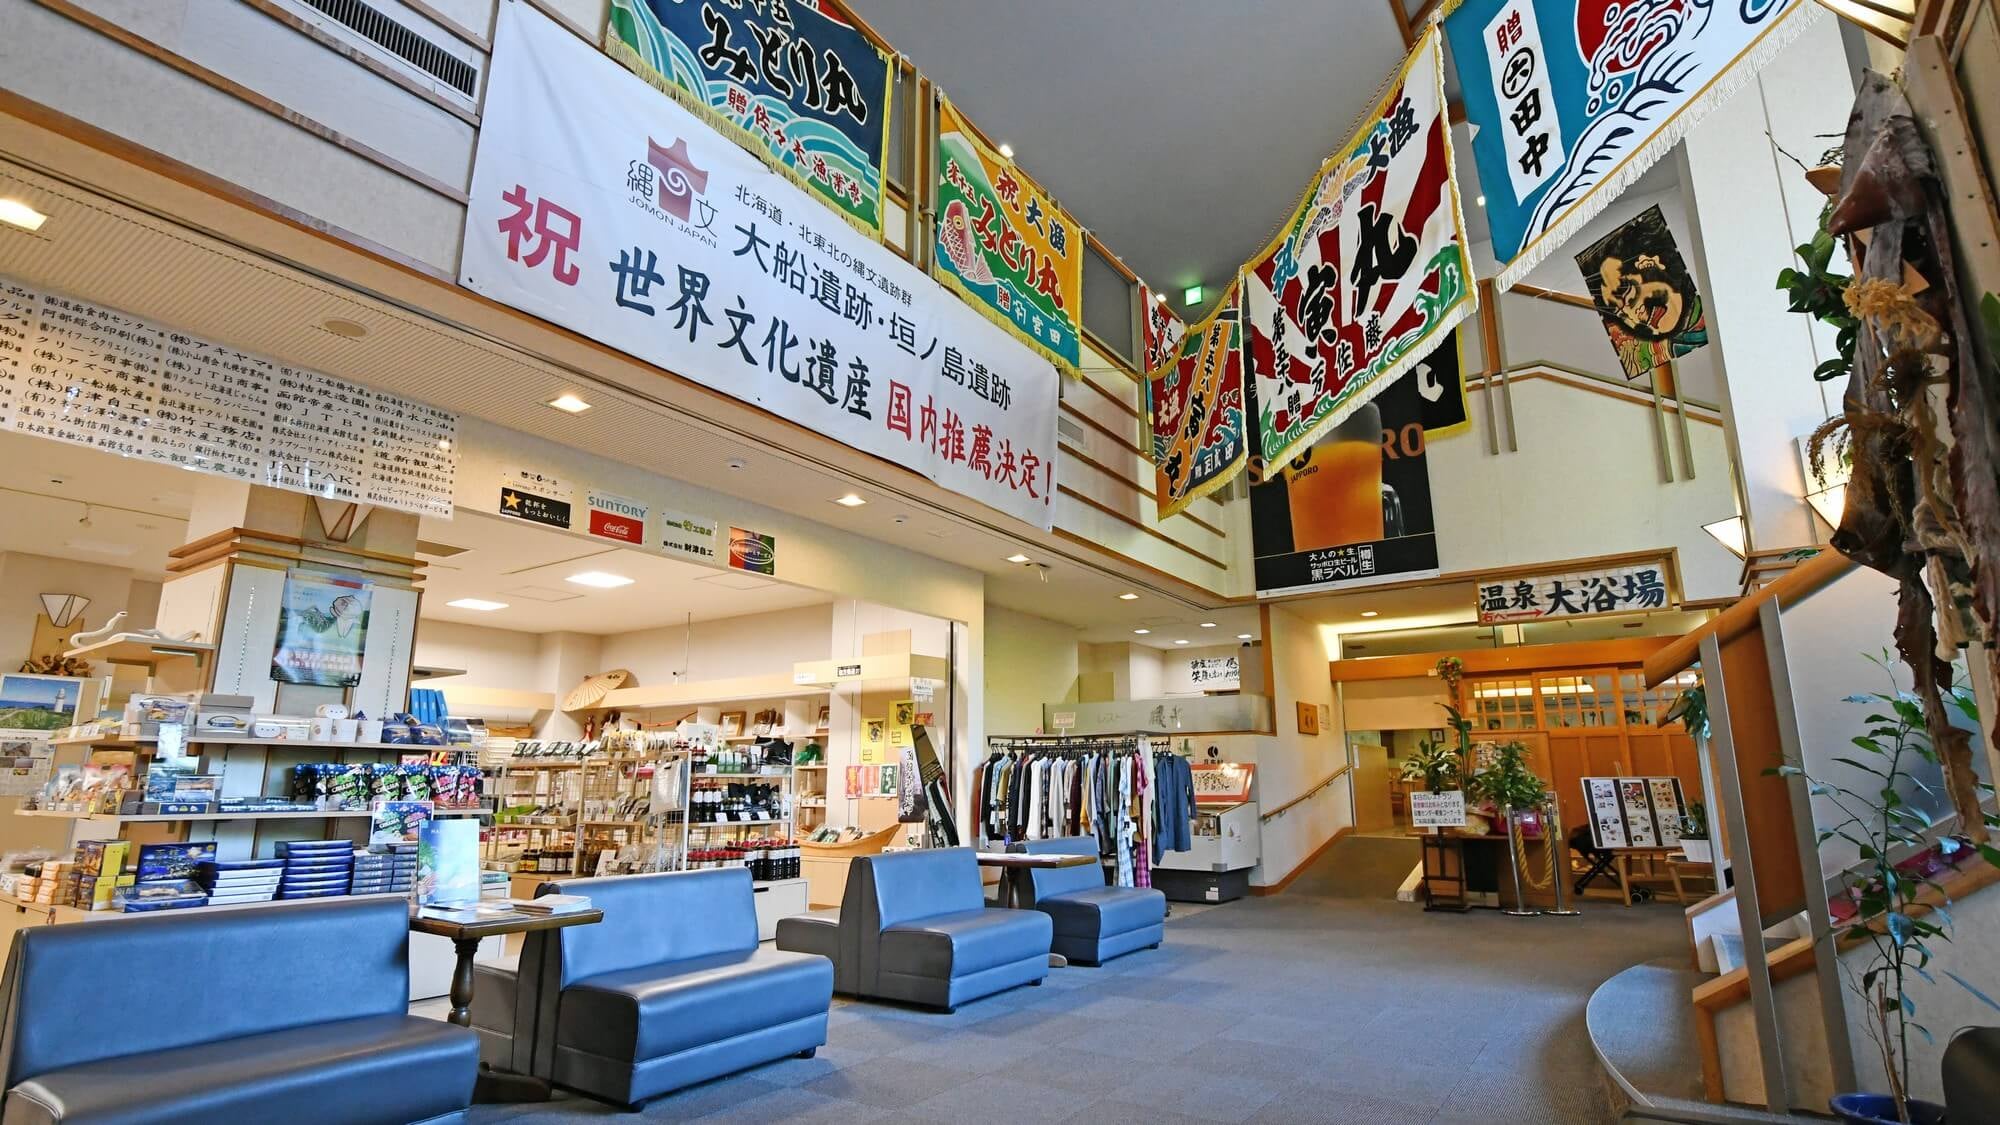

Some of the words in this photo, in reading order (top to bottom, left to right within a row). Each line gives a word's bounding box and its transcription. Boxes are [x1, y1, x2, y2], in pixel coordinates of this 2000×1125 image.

[700, 4, 868, 126] みどり丸
[1496, 9, 1523, 58] 贈
[728, 88, 748, 116] 贈
[1509, 88, 1549, 178] 田中
[498, 184, 582, 287] 祝
[628, 195, 676, 232] JOMON
[677, 223, 718, 249] JAPAN
[735, 184, 913, 309] 北海道・北東北の縄文遺跡群
[972, 196, 1064, 311] みどり丸
[609, 245, 873, 422] 世界文化遺産
[733, 221, 1012, 412] 大船遺跡・垣ノ島遺跡
[587, 495, 647, 519] SUNTORY
[1311, 564, 1359, 582] 黒ラベル
